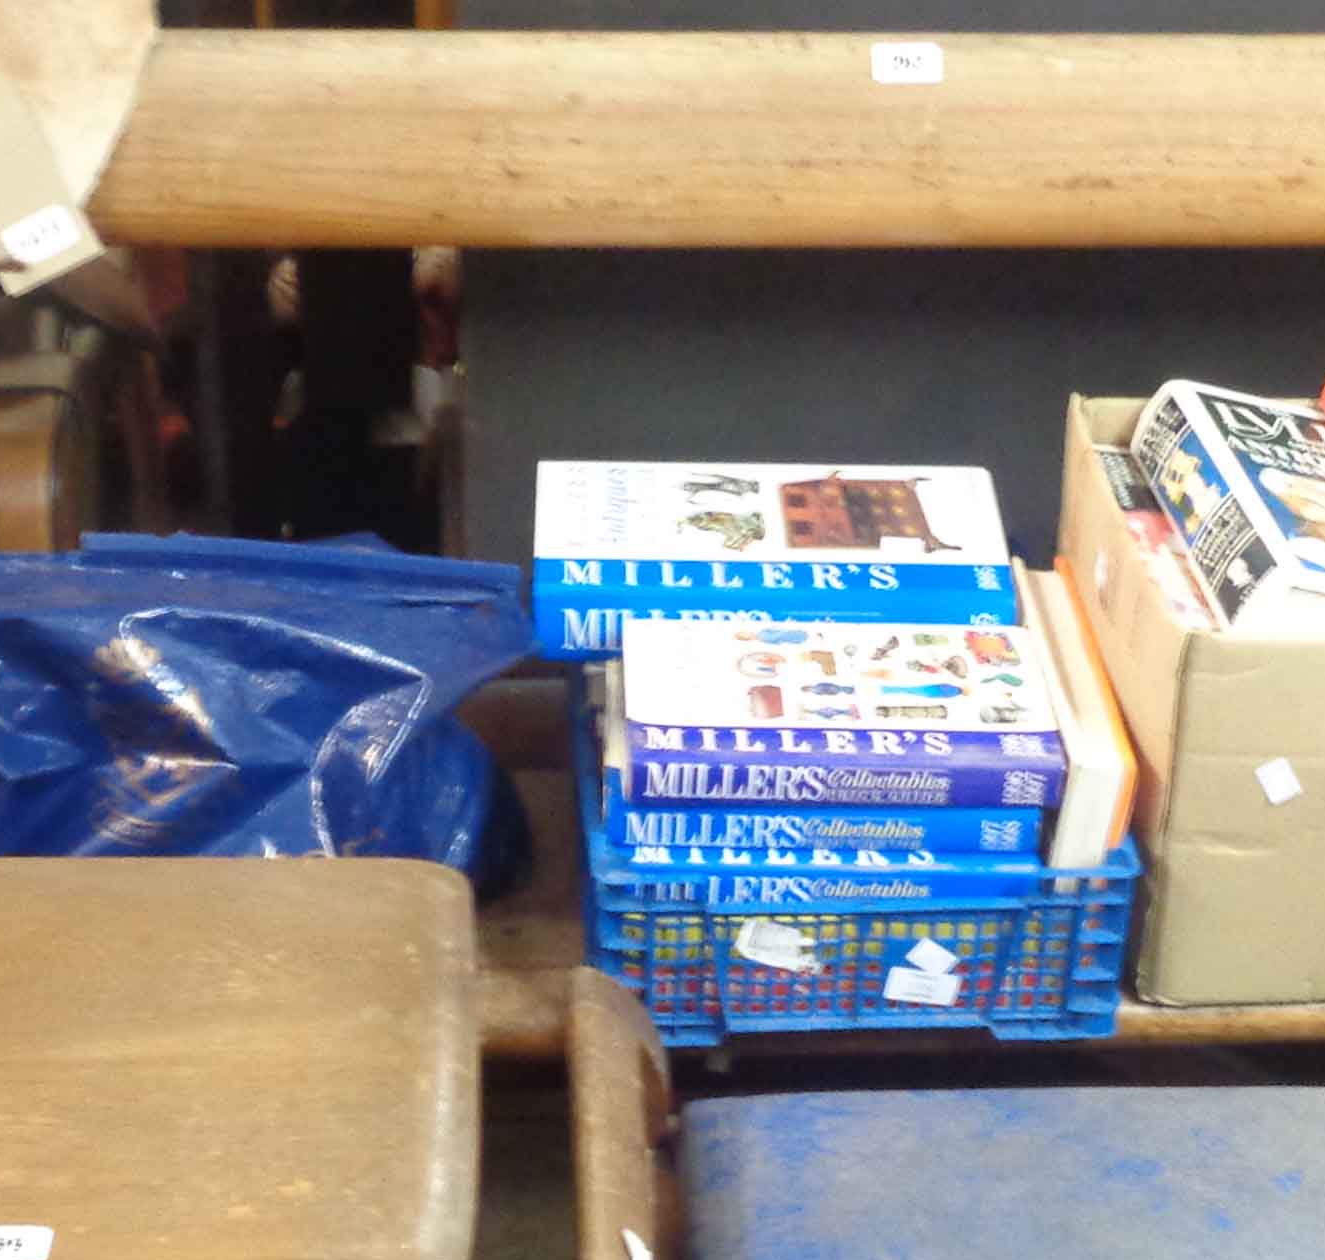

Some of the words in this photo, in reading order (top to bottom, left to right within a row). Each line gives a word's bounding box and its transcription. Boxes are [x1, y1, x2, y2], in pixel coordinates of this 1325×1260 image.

[561, 560, 900, 590] MILLER'S
[643, 726, 952, 754] MILLER'S
[643, 762, 826, 801] MILLER'S
[624, 812, 804, 848] MILLER'S
